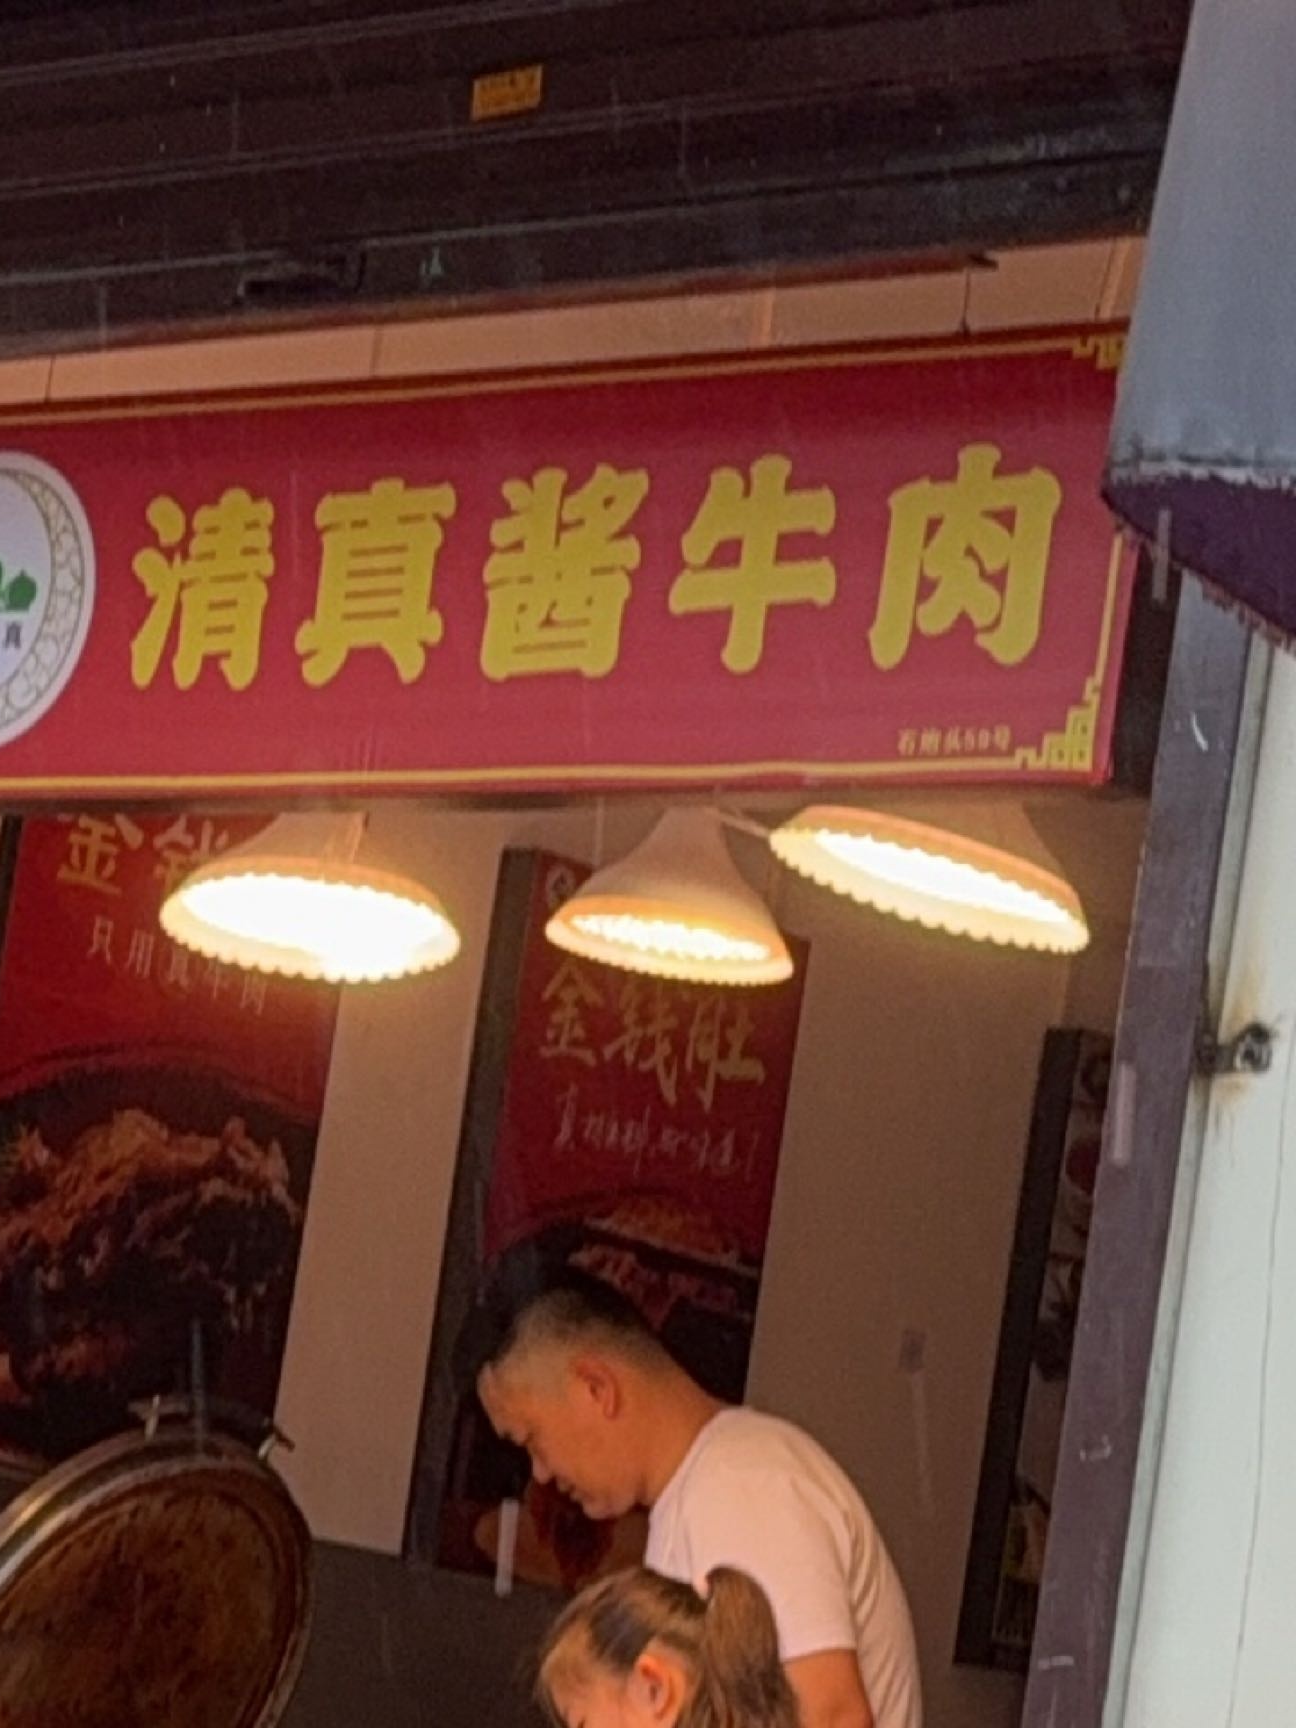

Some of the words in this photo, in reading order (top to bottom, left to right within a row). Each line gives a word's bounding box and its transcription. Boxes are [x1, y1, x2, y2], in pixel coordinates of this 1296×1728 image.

[131, 443, 1062, 691] 清真酱牛肉
